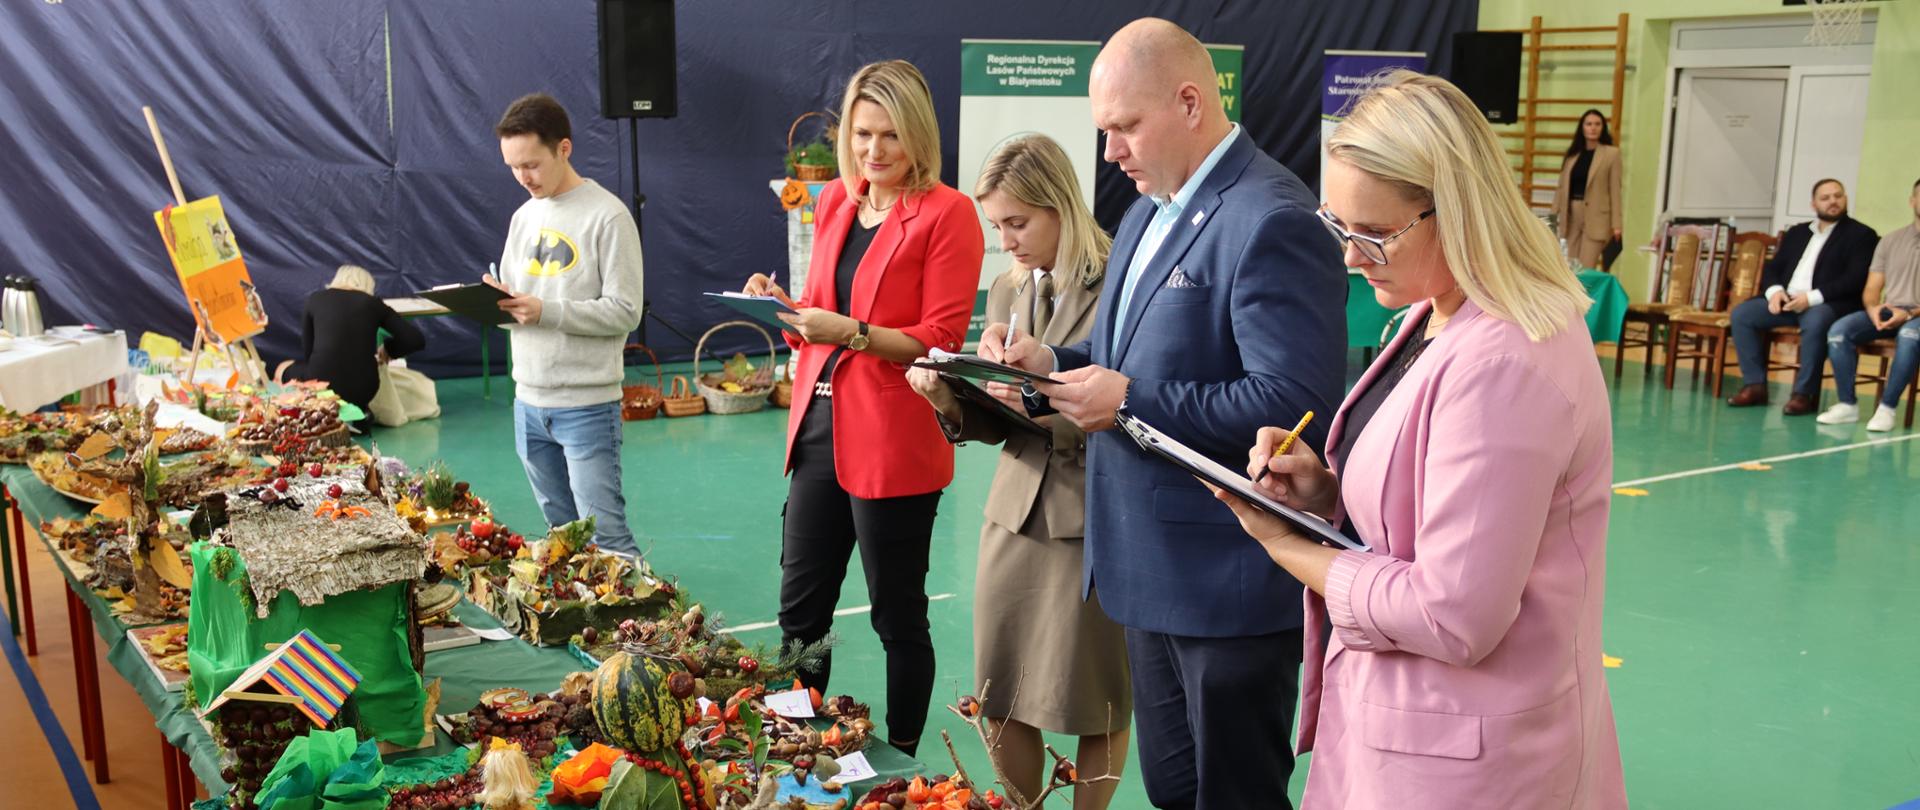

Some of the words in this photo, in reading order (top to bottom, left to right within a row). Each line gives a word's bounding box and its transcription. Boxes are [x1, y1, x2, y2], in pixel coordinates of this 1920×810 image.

[987, 54, 1036, 65] Regionalna
[1037, 55, 1076, 66] Dyrekcja
[986, 65, 1015, 75] Lasów
[1016, 65, 1076, 77] Państwowych
[1008, 76, 1062, 87] Białymstoku
[1217, 73, 1235, 90] AT
